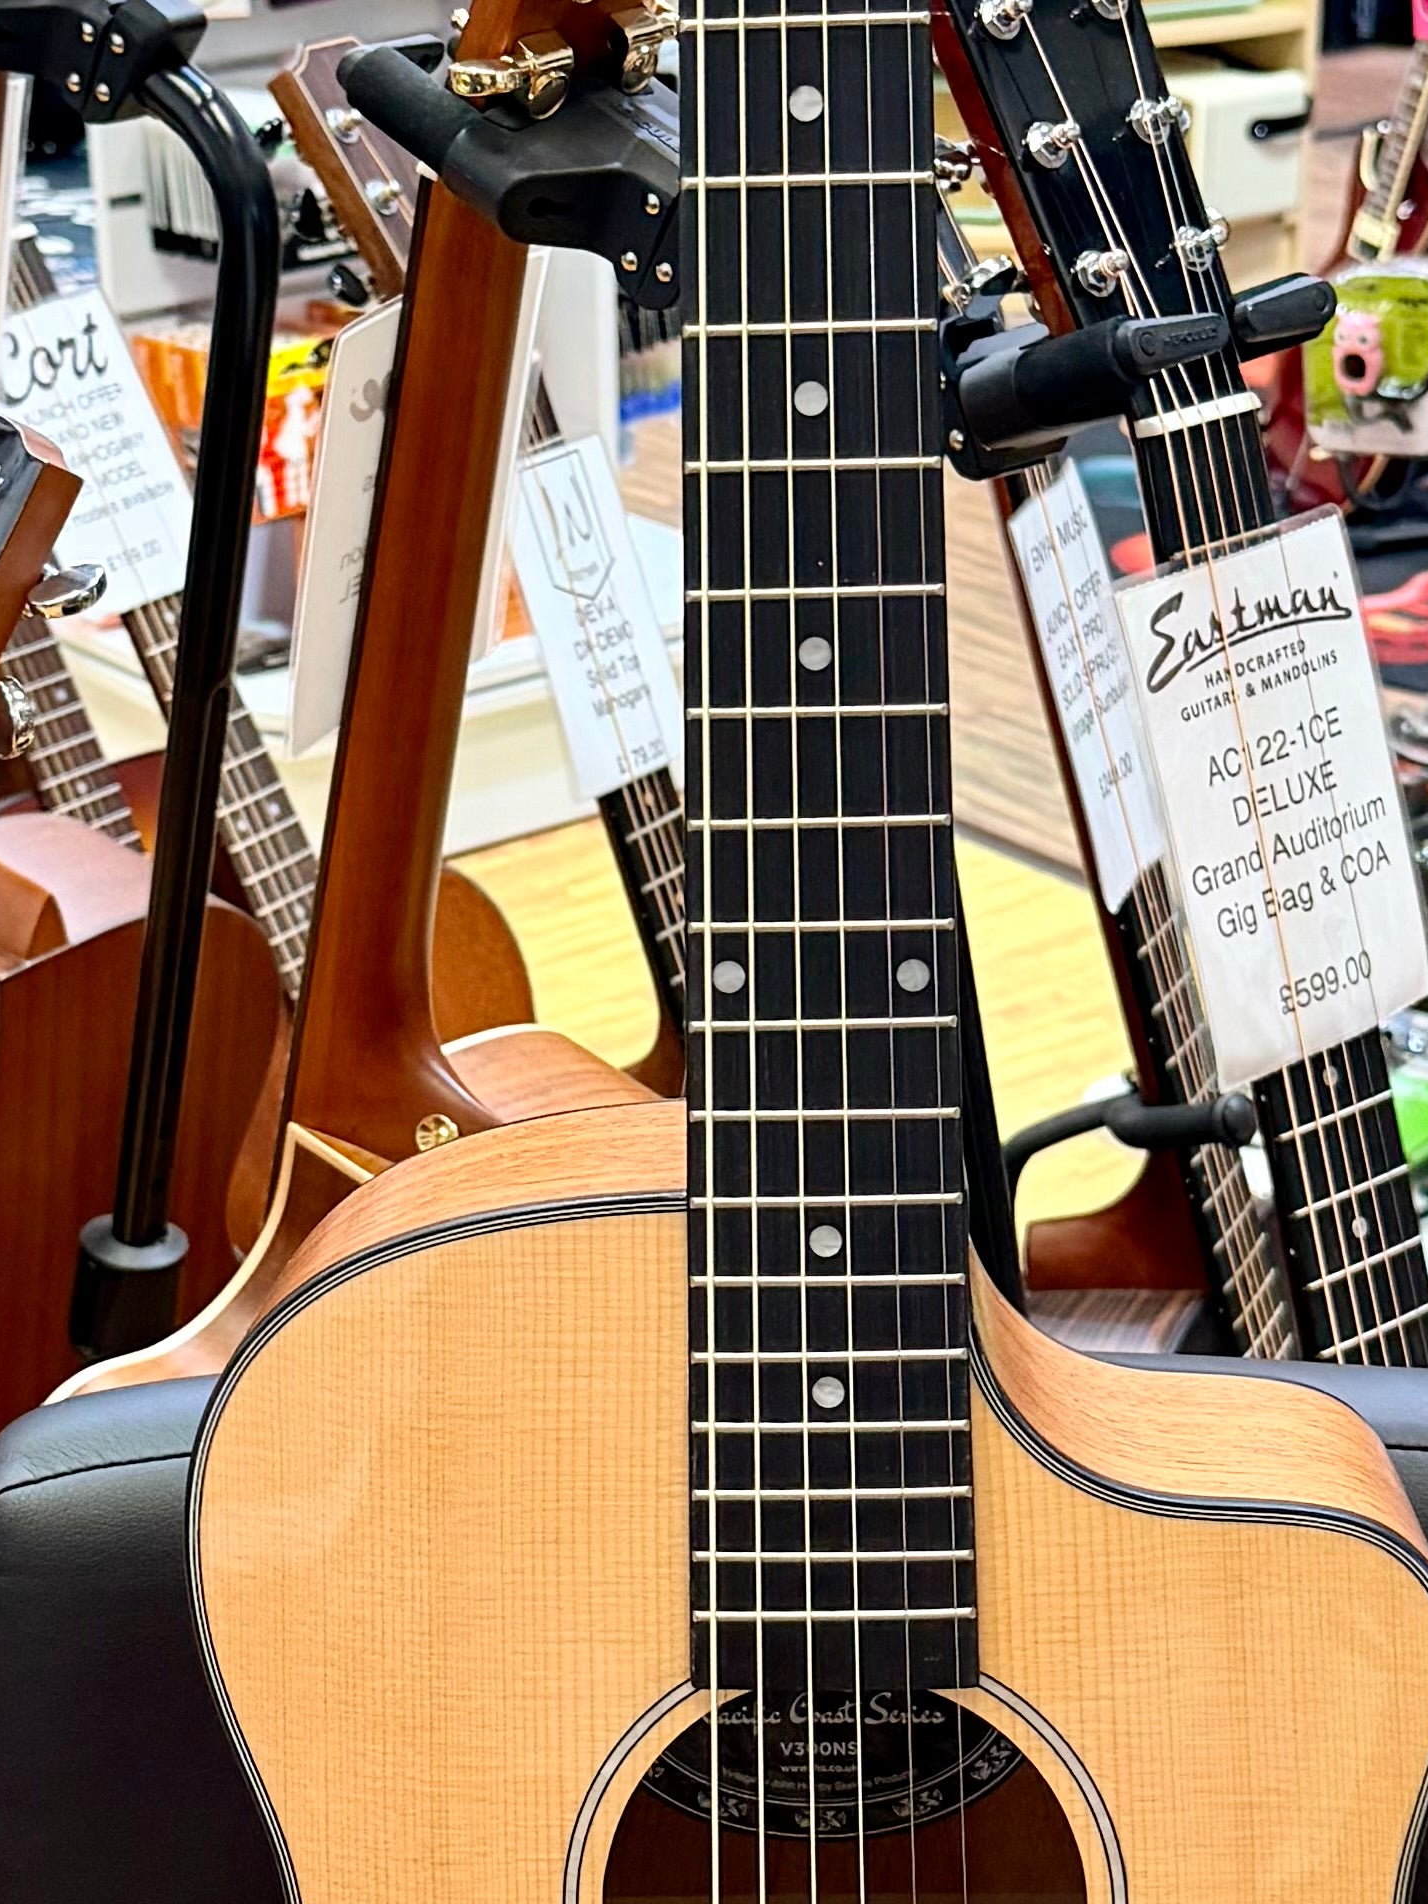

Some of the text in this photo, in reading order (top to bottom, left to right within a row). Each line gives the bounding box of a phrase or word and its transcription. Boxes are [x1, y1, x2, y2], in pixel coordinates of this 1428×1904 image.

[0, 312, 110, 407] Cort
[1146, 586, 1353, 695] Eastman
[1204, 638, 1306, 690] HANDCRAFTED
[1180, 649, 1339, 723] GUITARS & MANDOLINS
[1207, 706, 1343, 788] AC122-1CE
[1231, 760, 1338, 828] DELUXE
[1191, 795, 1388, 897] Grand Auditorium
[1216, 839, 1392, 939] Gig Bag & COA
[1278, 950, 1372, 1016] £599.00
[789, 1691, 858, 1725] Coast
[864, 1691, 946, 1726] Series
